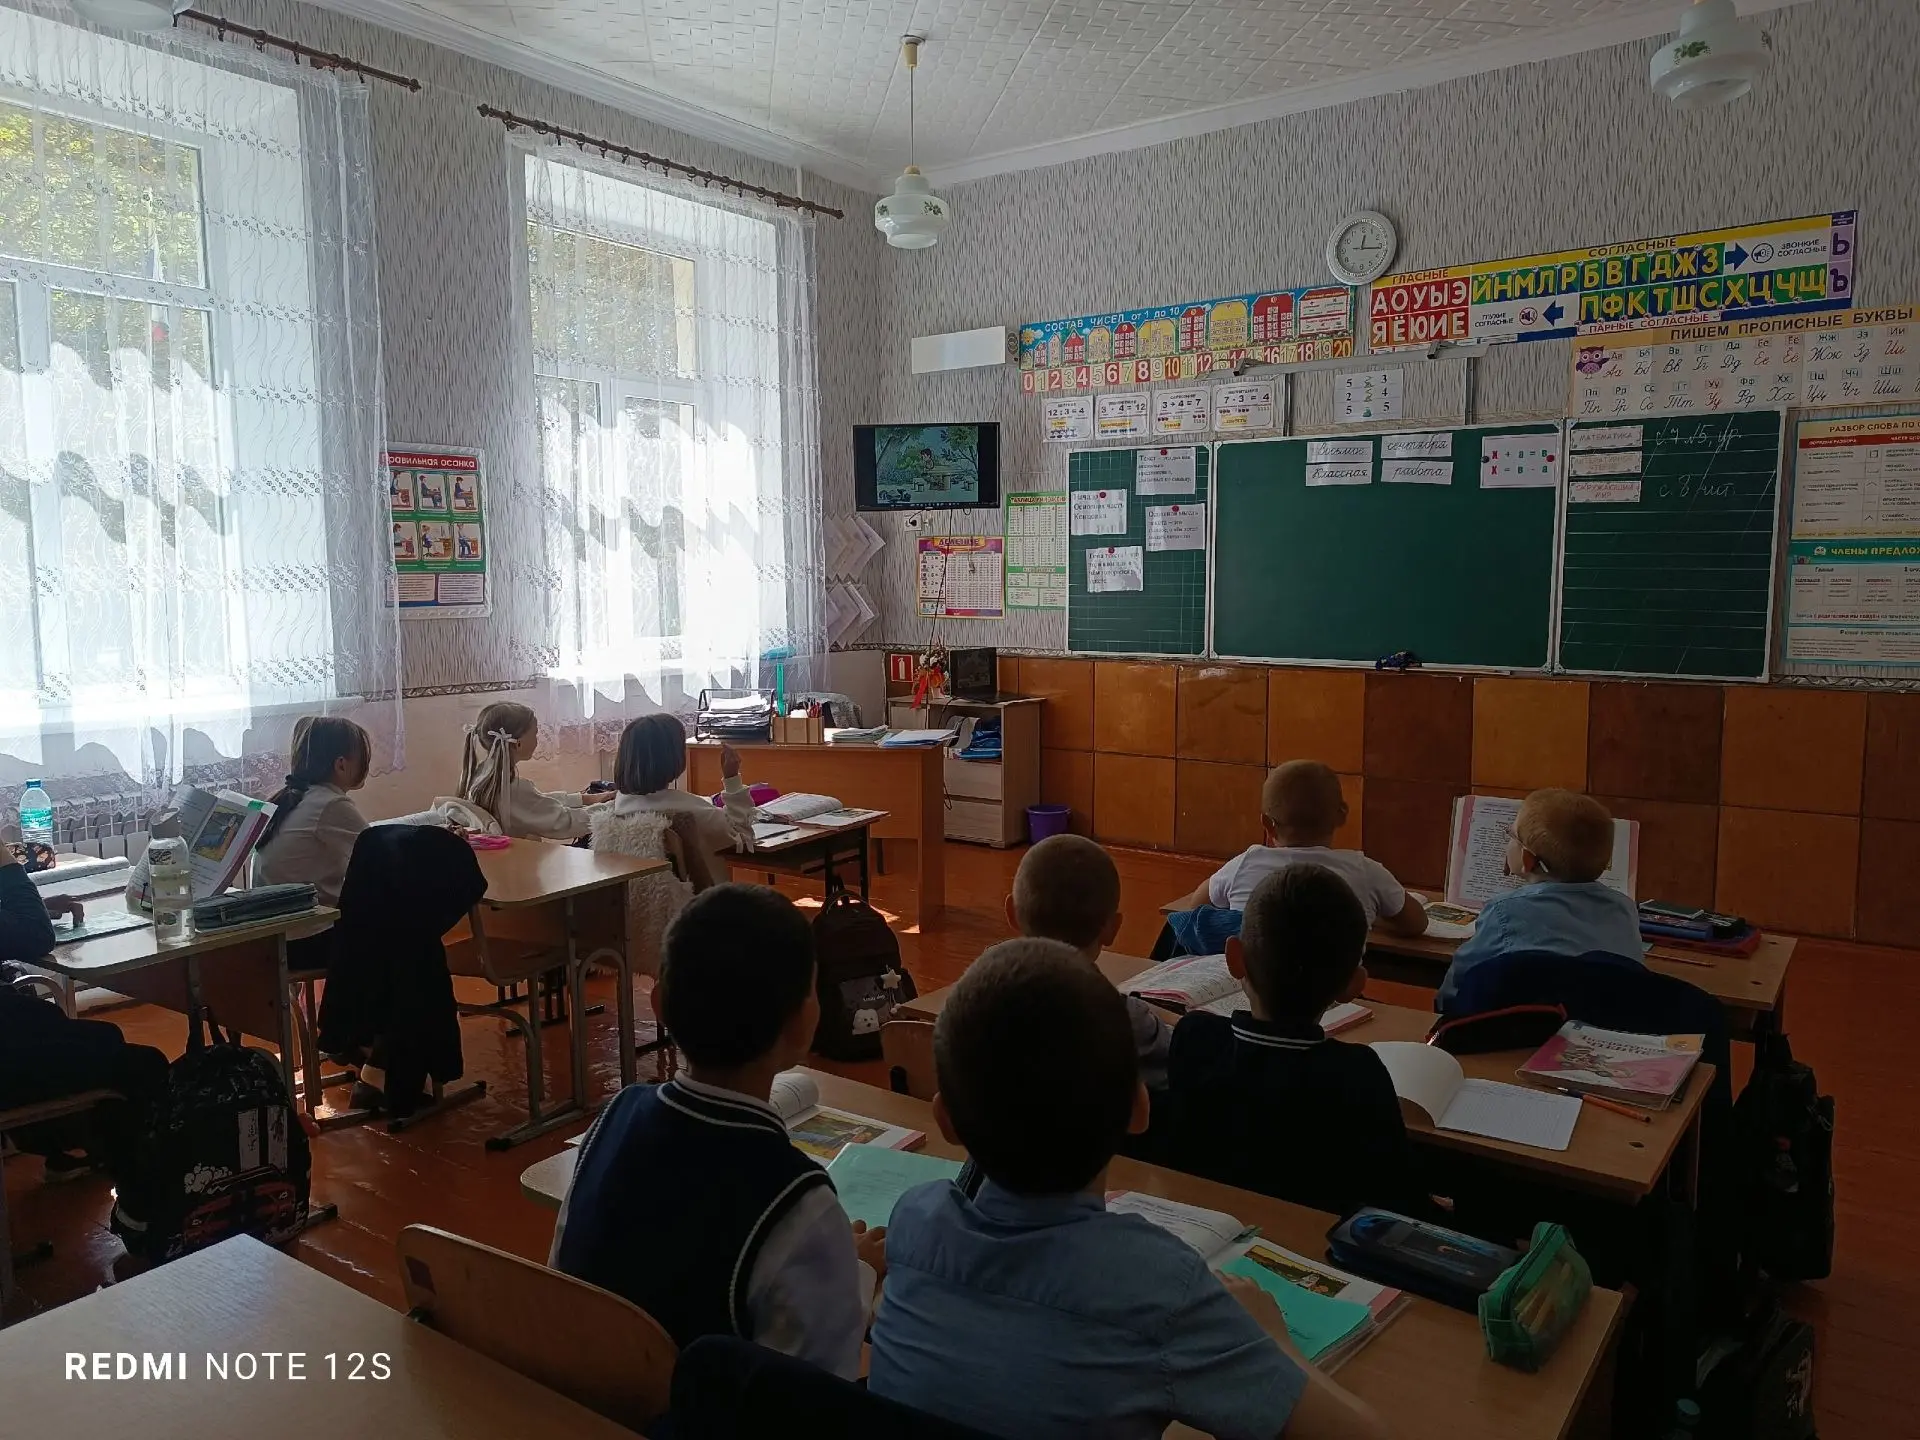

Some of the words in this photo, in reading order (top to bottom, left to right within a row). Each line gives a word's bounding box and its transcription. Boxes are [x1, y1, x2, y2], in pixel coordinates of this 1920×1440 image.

[1588, 237, 1677, 257] СОГЛАСНЫЕ
[1781, 239, 1820, 249] ЗВОНКИЕ
[1777, 246, 1827, 257] СОГЛАСНЫЕ
[1392, 268, 1450, 285] ГЛАСНЫЕ
[1830, 267, 1849, 293] Ъ
[1044, 319, 1084, 332] СОСТАВ
[1090, 314, 1125, 326] ЧИСЕЛ
[1154, 310, 1166, 320] до
[1169, 307, 1180, 316] 10
[1589, 321, 1634, 333] ПАРНЫЕ
[1640, 313, 1710, 328] СОГЛАСНЫЕ
[1670, 324, 1730, 341] ПИШЕМ
[1738, 314, 1843, 335] ПРОПИСНЫЕ
[1852, 307, 1913, 325] БУКВЫ
[1890, 326, 1905, 336] Ии
[1807, 345, 1844, 362] Жж
[1024, 373, 1034, 391] 0
[1037, 372, 1045, 391] 1
[1051, 370, 1061, 389] 2
[1064, 368, 1075, 387] 3
[1076, 367, 1088, 387] 4
[1092, 365, 1103, 384] 5
[1106, 363, 1118, 383] 6
[1122, 362, 1133, 382] 7
[1138, 361, 1150, 380] 8
[1152, 359, 1164, 378] 9
[1166, 358, 1180, 377] 10
[1182, 356, 1196, 376] 11
[1198, 354, 1212, 371] 12
[1264, 346, 1280, 364] 16
[1281, 346, 1297, 363] 17
[1298, 343, 1315, 361] 18
[1316, 341, 1332, 359] 19
[1333, 340, 1351, 358] 20
[1345, 378, 1353, 388] 5
[1380, 374, 1388, 384] 3
[1381, 387, 1389, 397] 4
[1765, 386, 1796, 402] Хх
[1872, 379, 1902, 395] Шш
[1345, 392, 1352, 401] 2
[1135, 403, 1146, 411] 12
[1345, 405, 1353, 415] 5
[1383, 401, 1390, 412] 5
[1829, 424, 1865, 433] РАЗБОР
[1867, 422, 1899, 431] СЛОВА
[1902, 421, 1915, 429] ПО
[440, 458, 476, 468] осанка
[1311, 467, 1368, 480] Классная
[1391, 461, 1445, 480] работа
[1831, 548, 1869, 556] ЧЛЕНЫ
